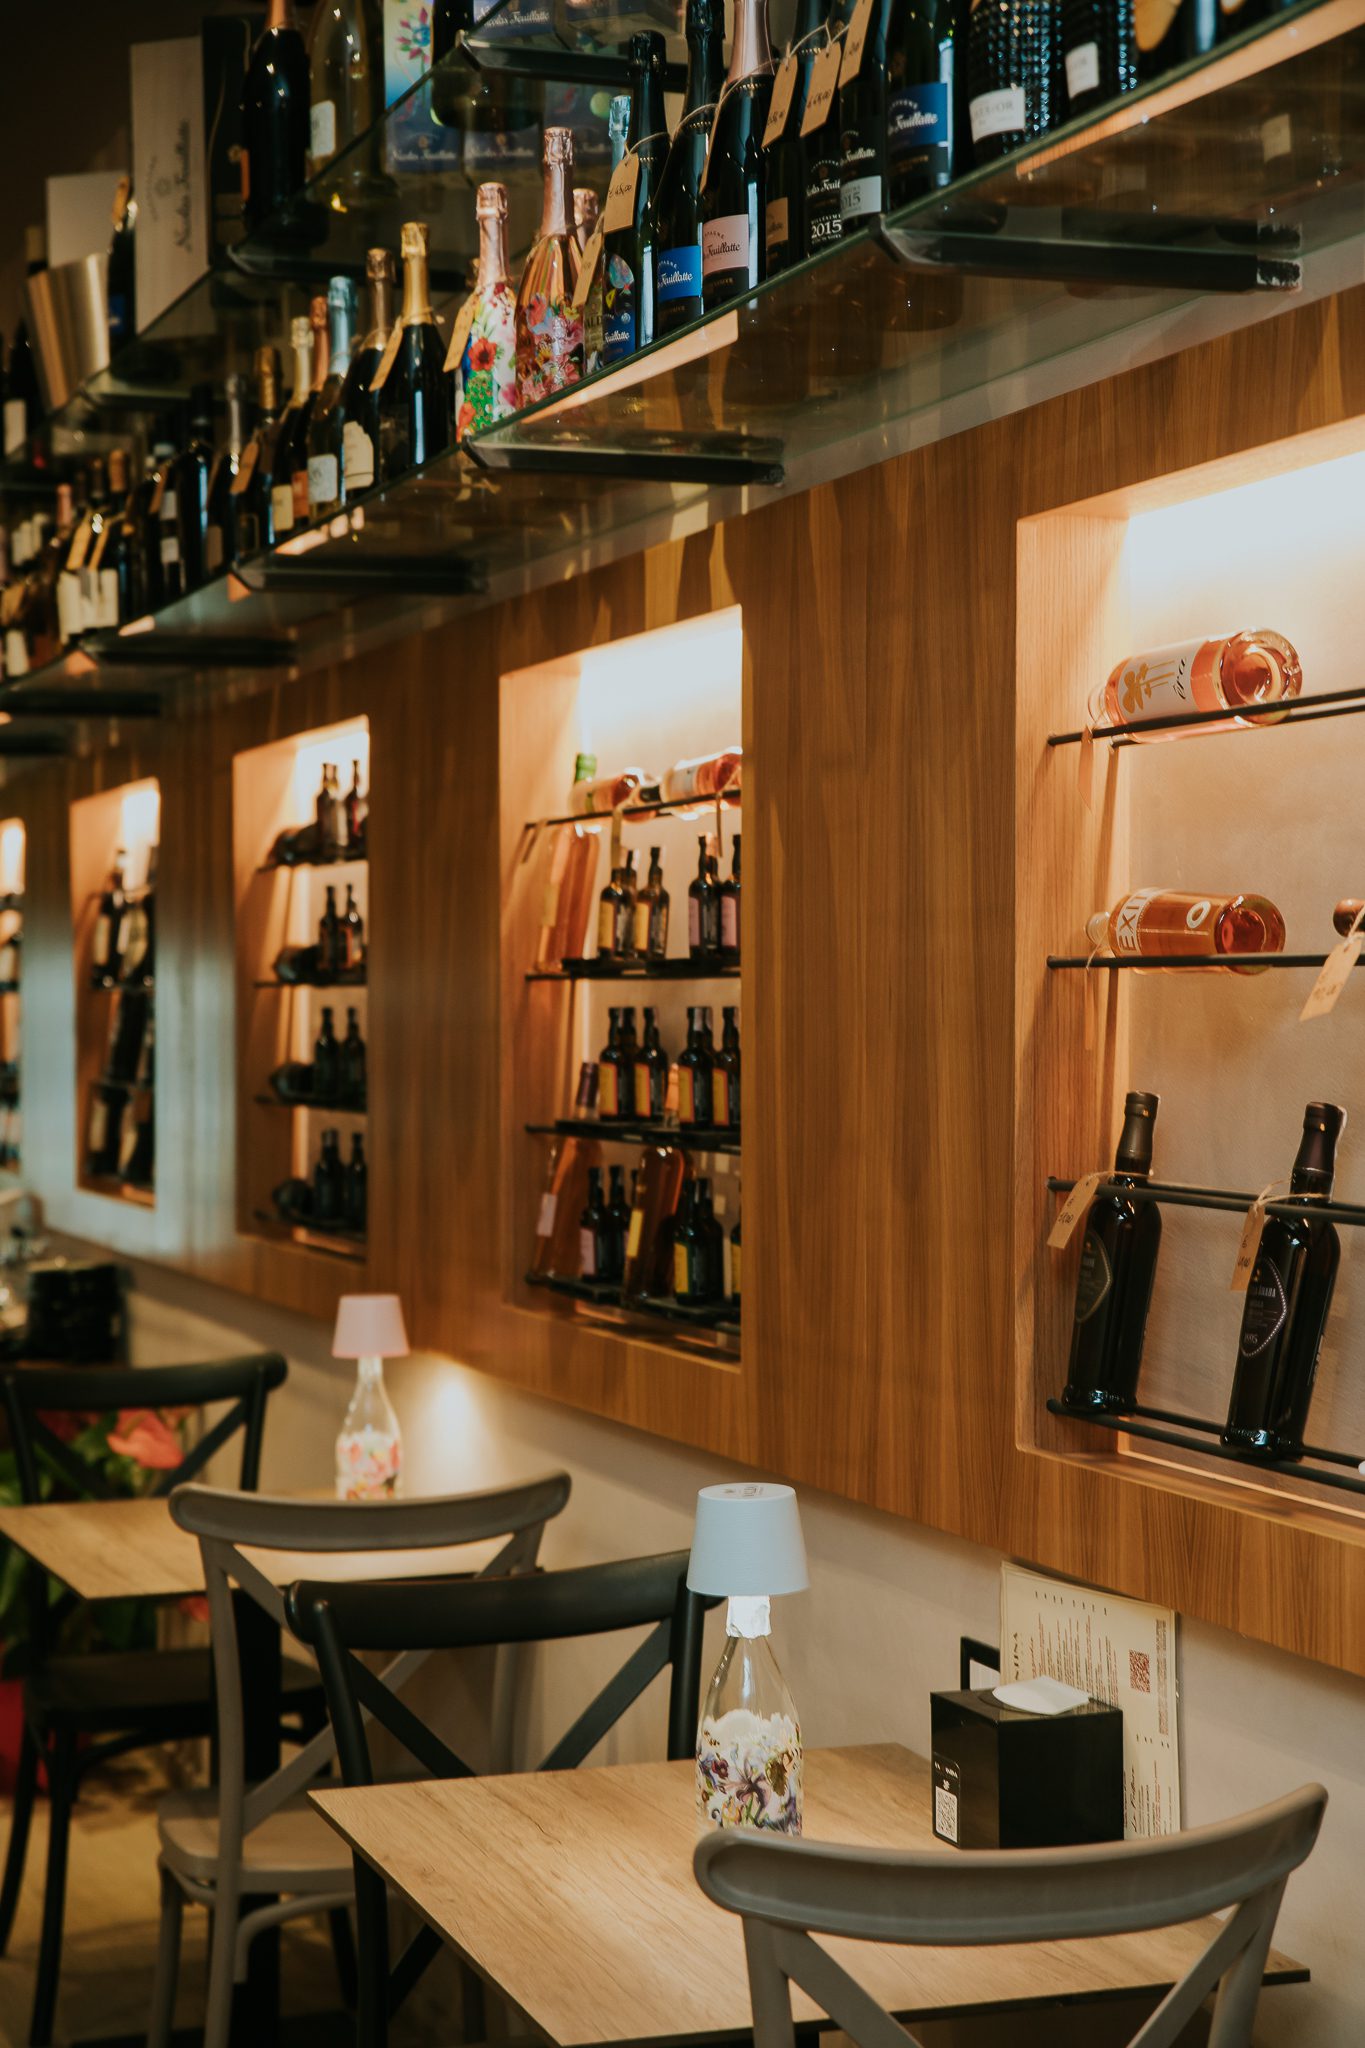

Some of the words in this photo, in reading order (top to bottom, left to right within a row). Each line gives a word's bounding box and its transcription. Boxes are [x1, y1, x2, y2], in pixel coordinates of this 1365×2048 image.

[811, 219, 842, 239] 2015
[707, 242, 740, 256] Feuillatte
[661, 271, 693, 287] Feuillatte
